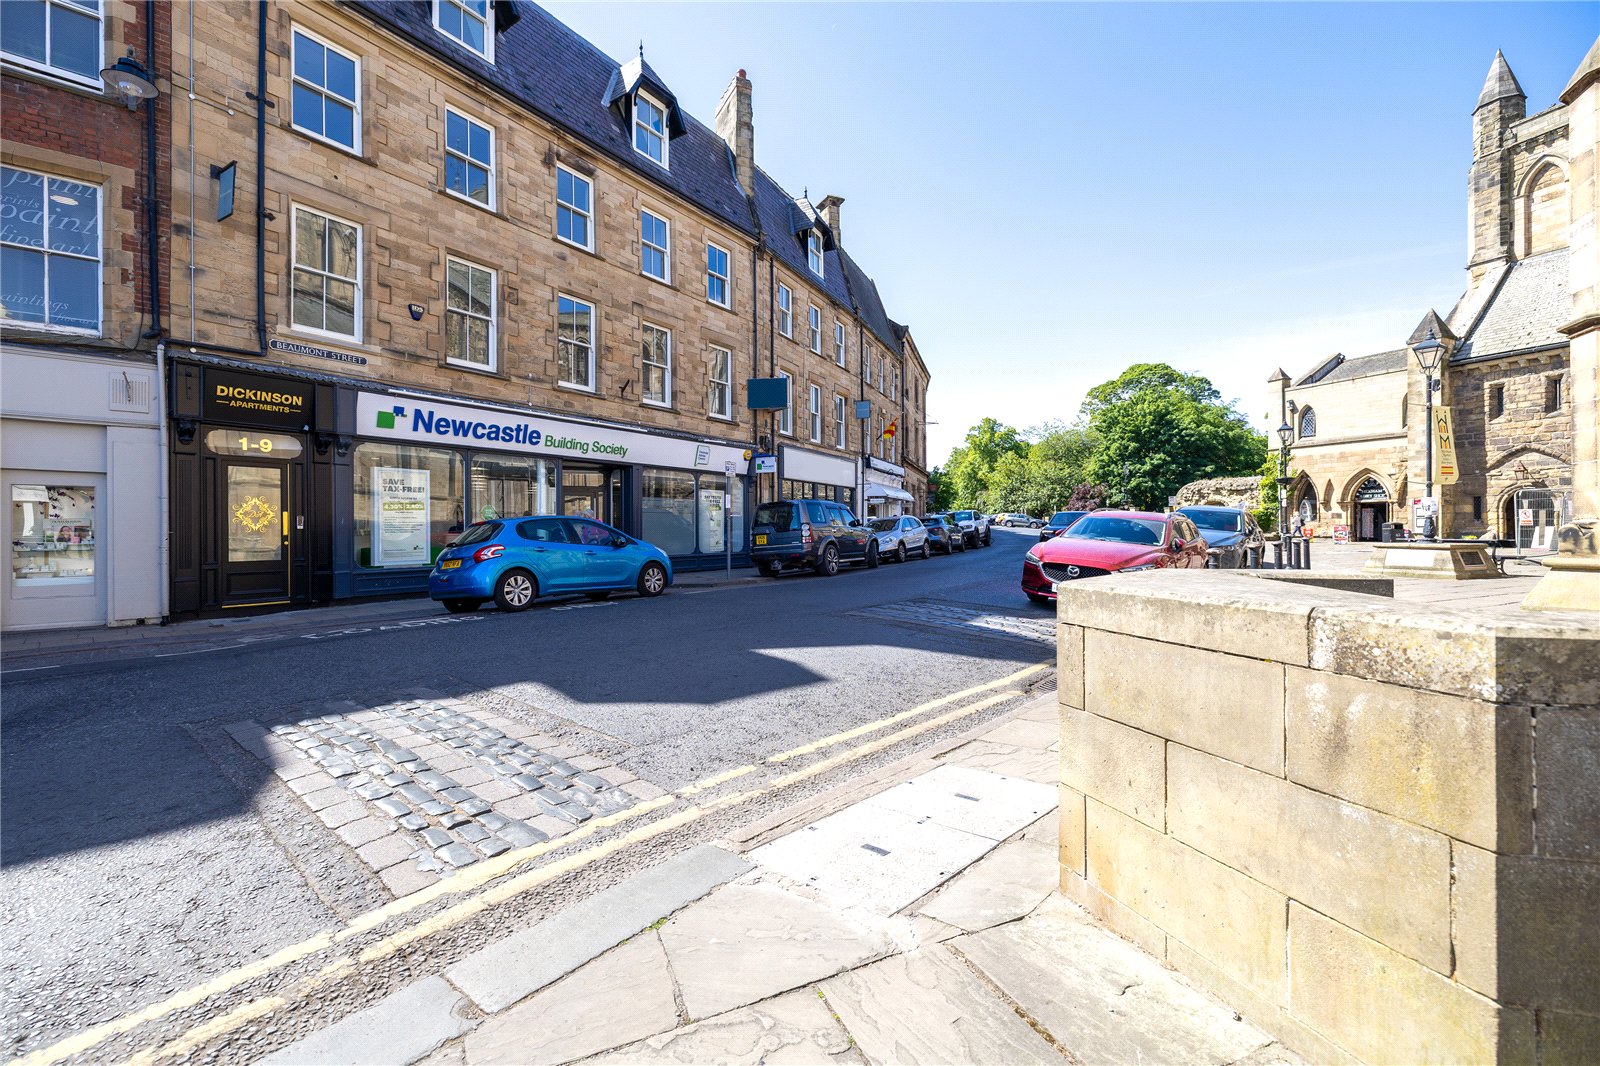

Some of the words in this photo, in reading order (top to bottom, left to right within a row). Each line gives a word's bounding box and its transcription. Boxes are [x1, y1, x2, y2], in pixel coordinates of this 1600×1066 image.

[0, 194, 40, 208] rints
[276, 341, 329, 358] BEAUMONT
[331, 352, 363, 364] STREET
[216, 385, 303, 406] DICKINSON
[229, 400, 290, 413] APARTMENTS
[412, 408, 541, 446] Newcastle
[545, 434, 589, 454] Building
[591, 441, 629, 458] Society
[238, 437, 273, 453] 1-9
[382, 478, 405, 486] SAVE
[382, 485, 425, 493] TAX-FREE!
